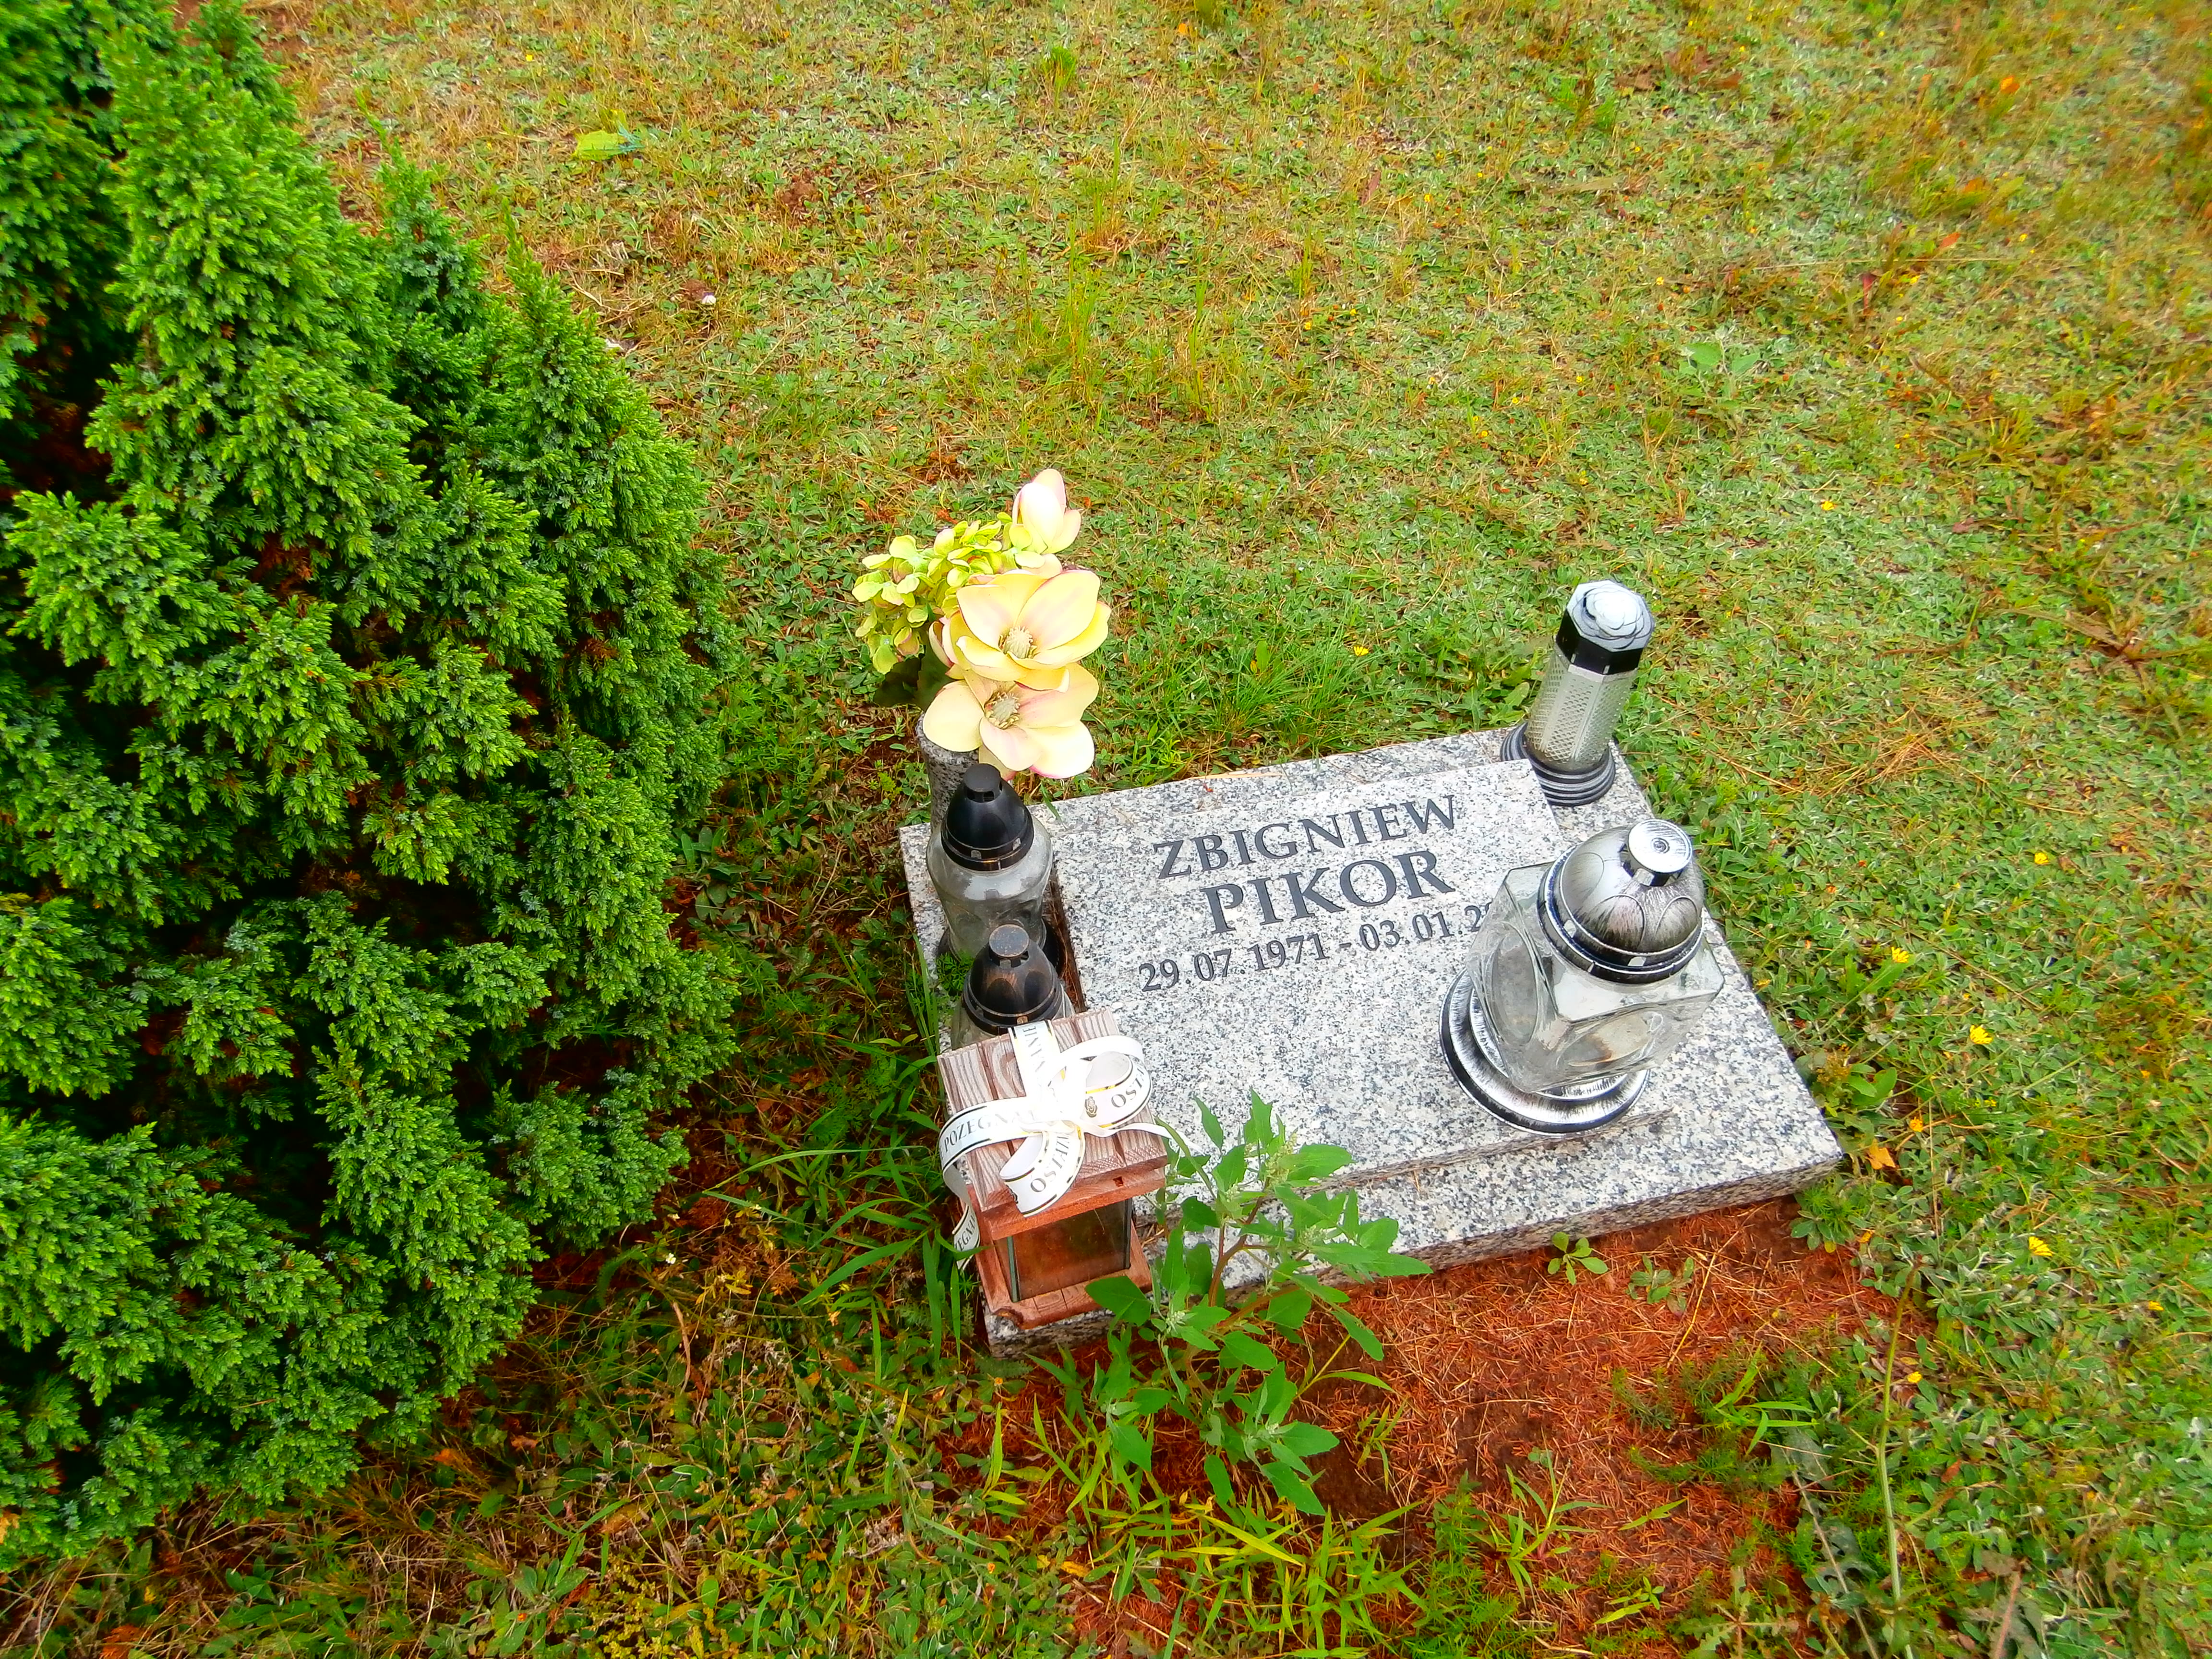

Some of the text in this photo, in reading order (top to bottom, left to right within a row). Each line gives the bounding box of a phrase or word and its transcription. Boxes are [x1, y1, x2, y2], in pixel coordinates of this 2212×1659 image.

[1153, 794, 1455, 879] ZBIGNIEW
[1200, 850, 1456, 934] PIKOR
[1359, 897, 1493, 951] 03.01.2
